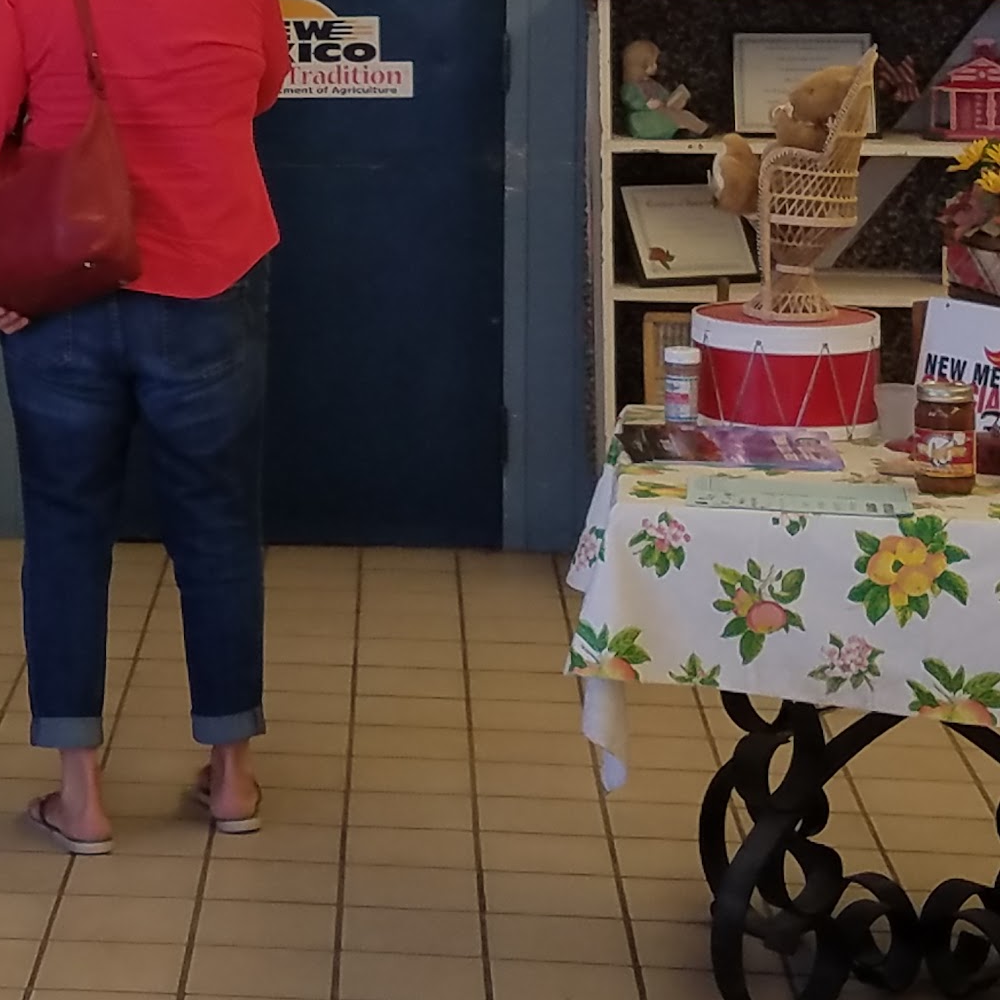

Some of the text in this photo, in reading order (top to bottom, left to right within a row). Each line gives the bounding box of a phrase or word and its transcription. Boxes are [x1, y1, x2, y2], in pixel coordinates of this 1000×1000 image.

[290, 65, 402, 84] Tradition
[279, 86, 398, 95] ment of Agriculture
[924, 353, 967, 381] NEW
